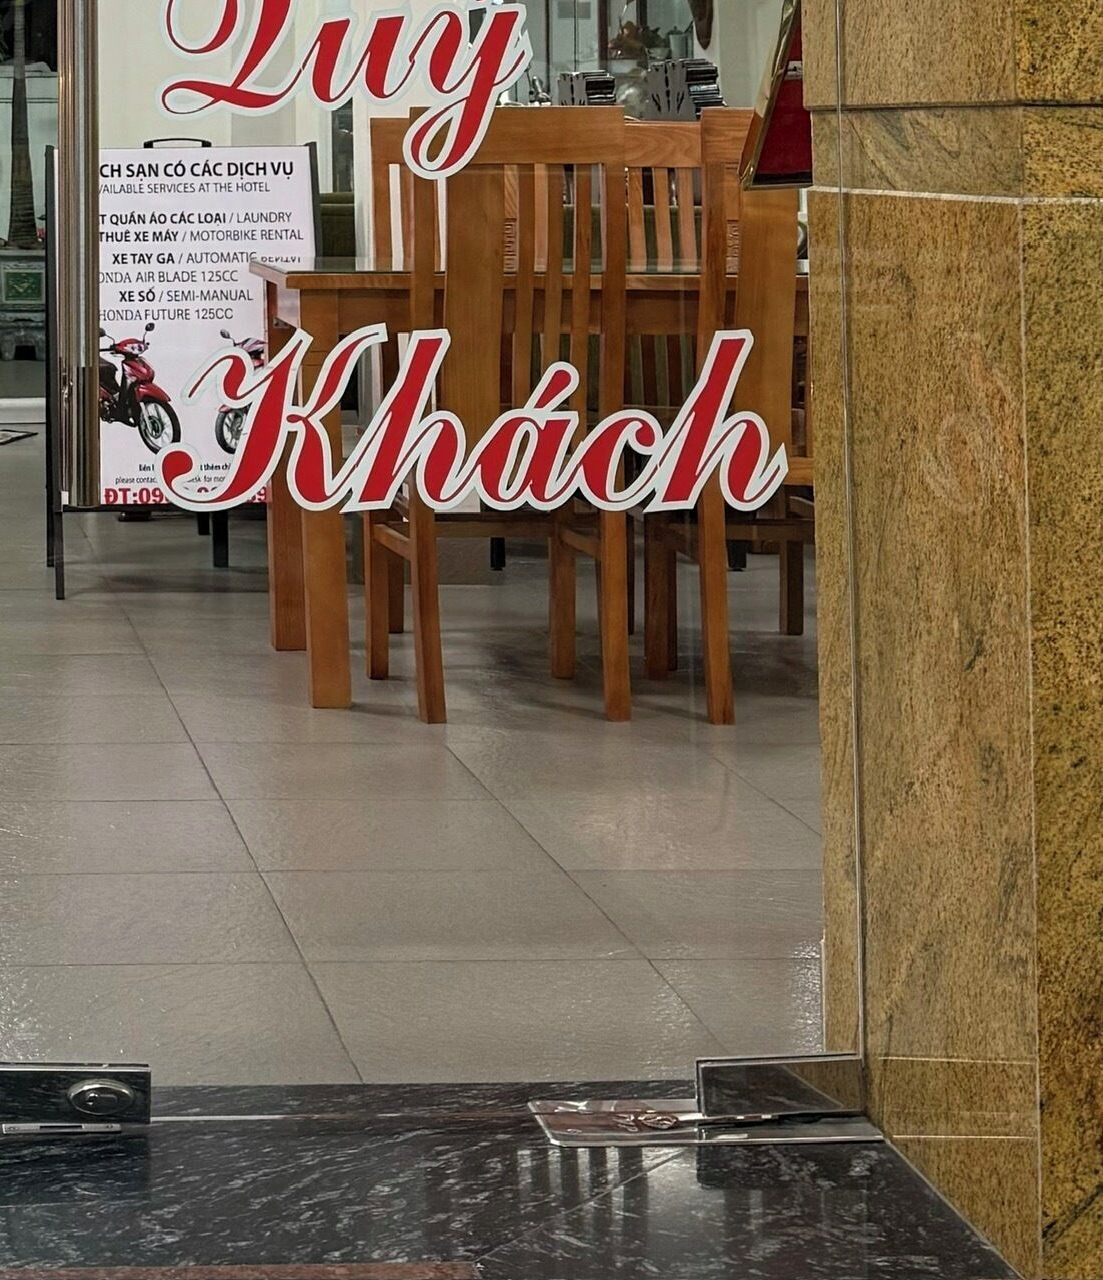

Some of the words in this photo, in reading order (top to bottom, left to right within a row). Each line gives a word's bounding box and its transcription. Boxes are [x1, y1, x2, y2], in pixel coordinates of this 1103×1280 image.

[99, 163, 121, 178] CH
[126, 162, 159, 181] SẠN
[164, 160, 186, 177] CÓ
[190, 160, 223, 177] CÁC
[227, 161, 267, 180] DỊCH
[270, 161, 294, 180] VỤ
[100, 183, 144, 194] AILABLE
[147, 182, 196, 193] SERVICES
[198, 182, 211, 193] AT
[214, 182, 233, 193] THE
[236, 181, 270, 192] HOTEL
[149, 210, 167, 224] ÁO
[170, 210, 195, 224] CÁC
[198, 212, 226, 227] LOẠI
[236, 211, 292, 223] LAUNDRY
[134, 231, 149, 242] XE
[152, 228, 179, 242] MÁY
[190, 229, 257, 242] MOTORBIKE
[261, 228, 304, 240] RENTAL
[112, 253, 128, 265] XE
[130, 253, 153, 264] TAY
[156, 252, 175, 264] GA
[99, 272, 132, 283] ONDA
[135, 271, 155, 283] AIR
[158, 271, 197, 283] BLADE
[201, 270, 238, 282] 125CC
[119, 291, 134, 302] XE
[167, 290, 253, 302] SEMI-MANUAL
[144, 309, 191, 321] FUTURE
[195, 308, 233, 320] 125CC
[159, 322, 789, 512] Khách
[136, 475, 158, 484] contac
